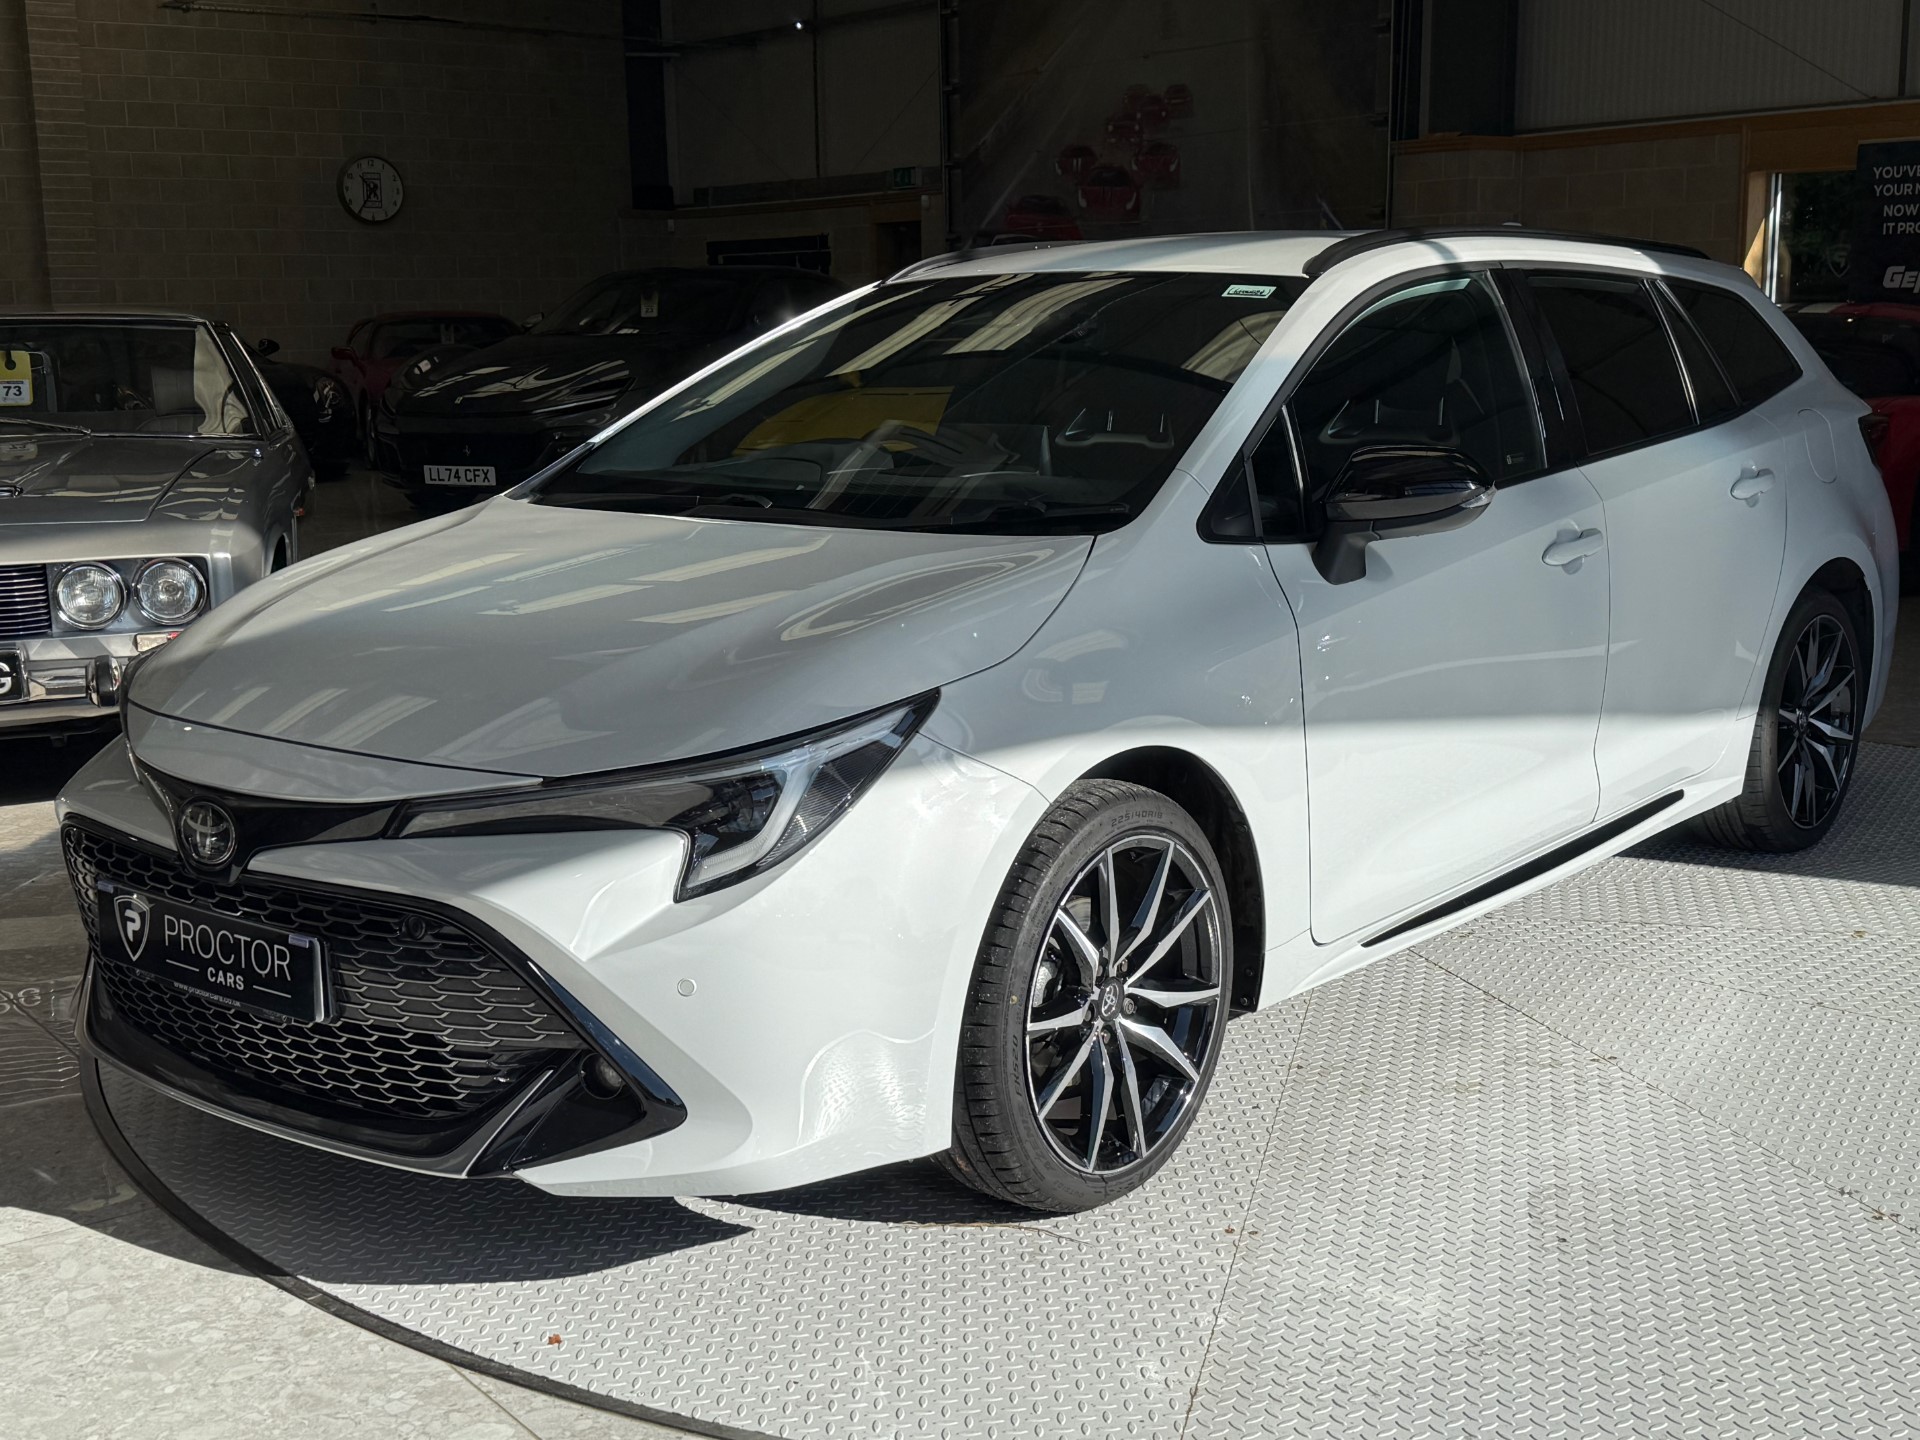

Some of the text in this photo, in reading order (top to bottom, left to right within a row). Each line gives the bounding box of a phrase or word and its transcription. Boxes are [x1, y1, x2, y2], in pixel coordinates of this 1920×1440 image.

[1874, 184, 1913, 197] YOUR
[1883, 204, 1920, 217] NOW
[1882, 222, 1896, 235] IT
[2, 385, 23, 397] 73
[428, 467, 491, 483] LL74 CFX
[164, 914, 292, 981] PROCTOR
[207, 966, 244, 991] CARS
[173, 981, 241, 1007] www.proctorcars.co.uk
